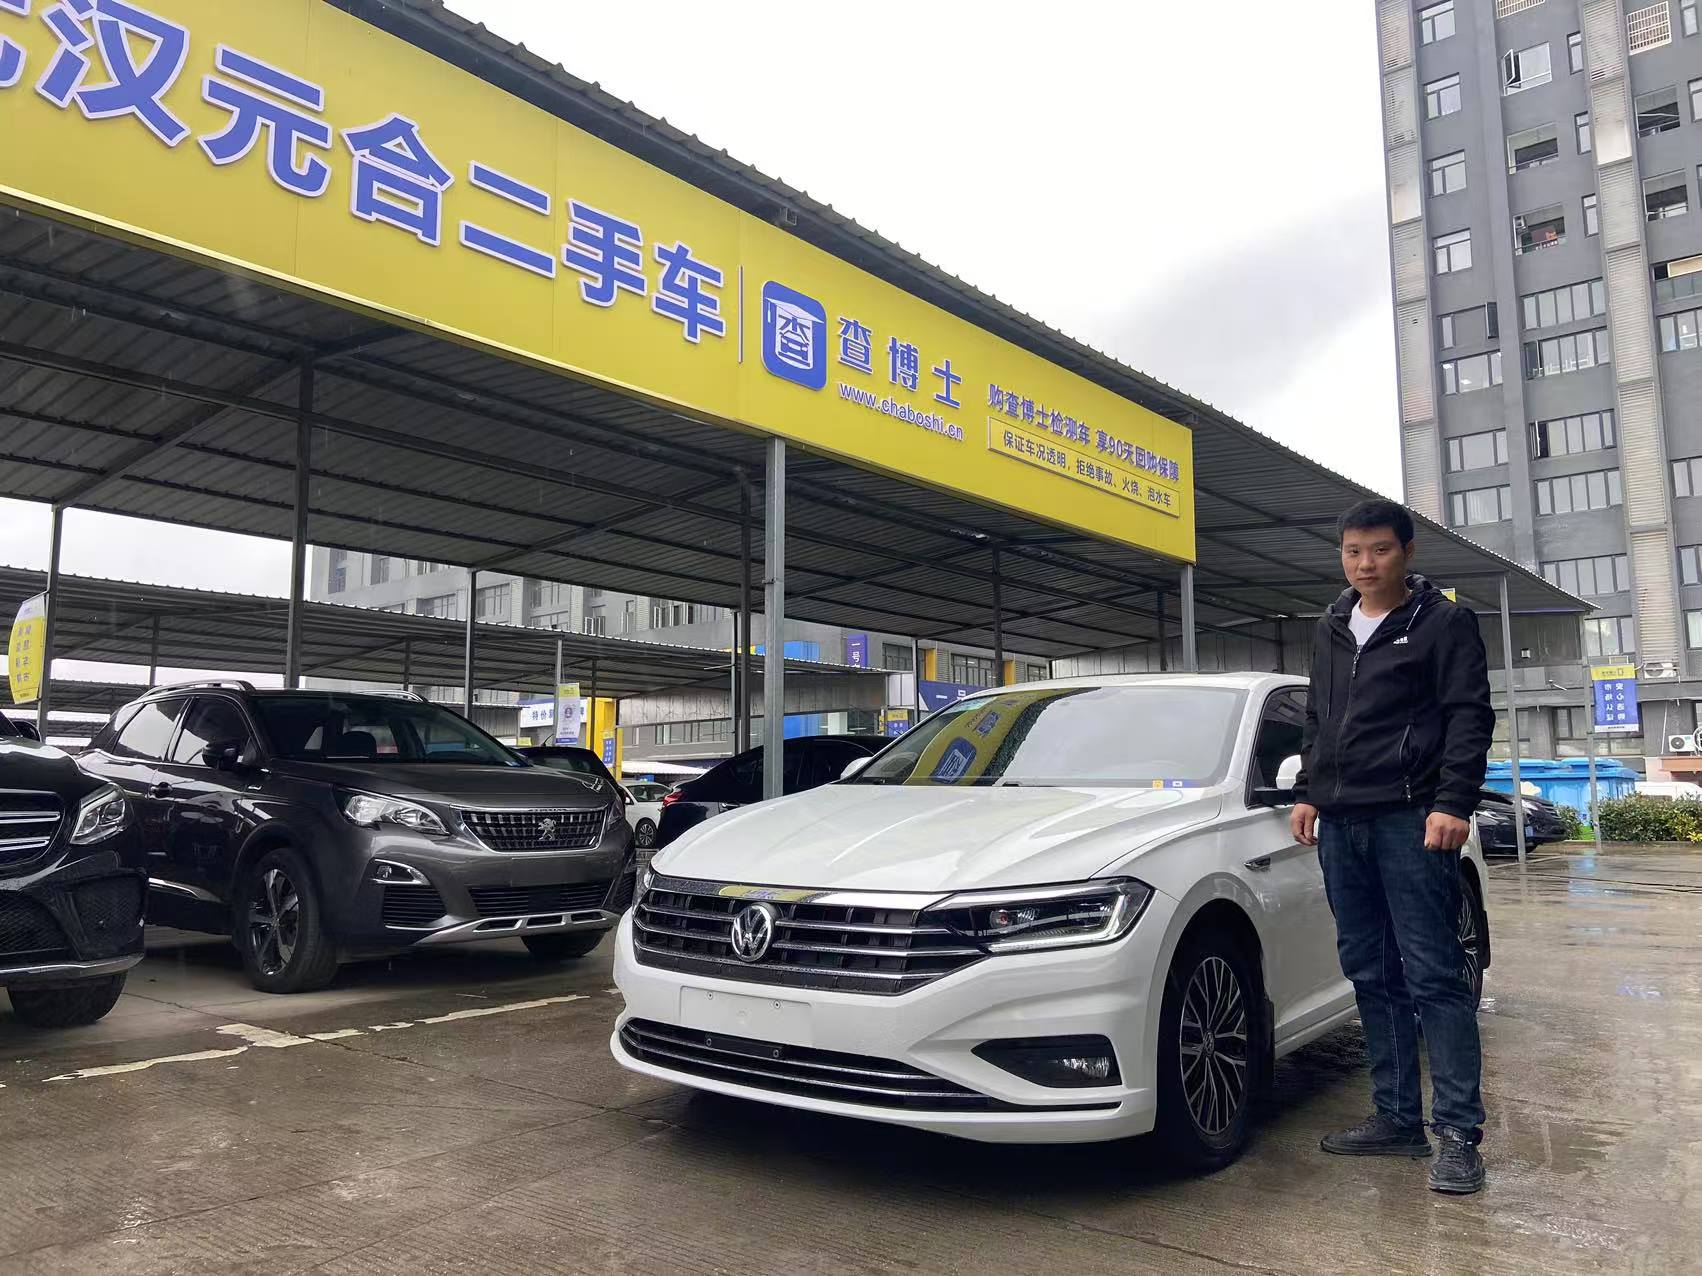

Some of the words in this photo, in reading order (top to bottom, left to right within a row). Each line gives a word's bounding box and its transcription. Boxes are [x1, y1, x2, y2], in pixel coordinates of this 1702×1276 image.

[0, 0, 726, 344] 汉元合二手车
[837, 316, 962, 408] 查博士
[838, 382, 964, 442] www.chaboshi.cn
[987, 383, 1090, 446] 购查博士检测车
[1095, 428, 1180, 483] 享90天回购保障
